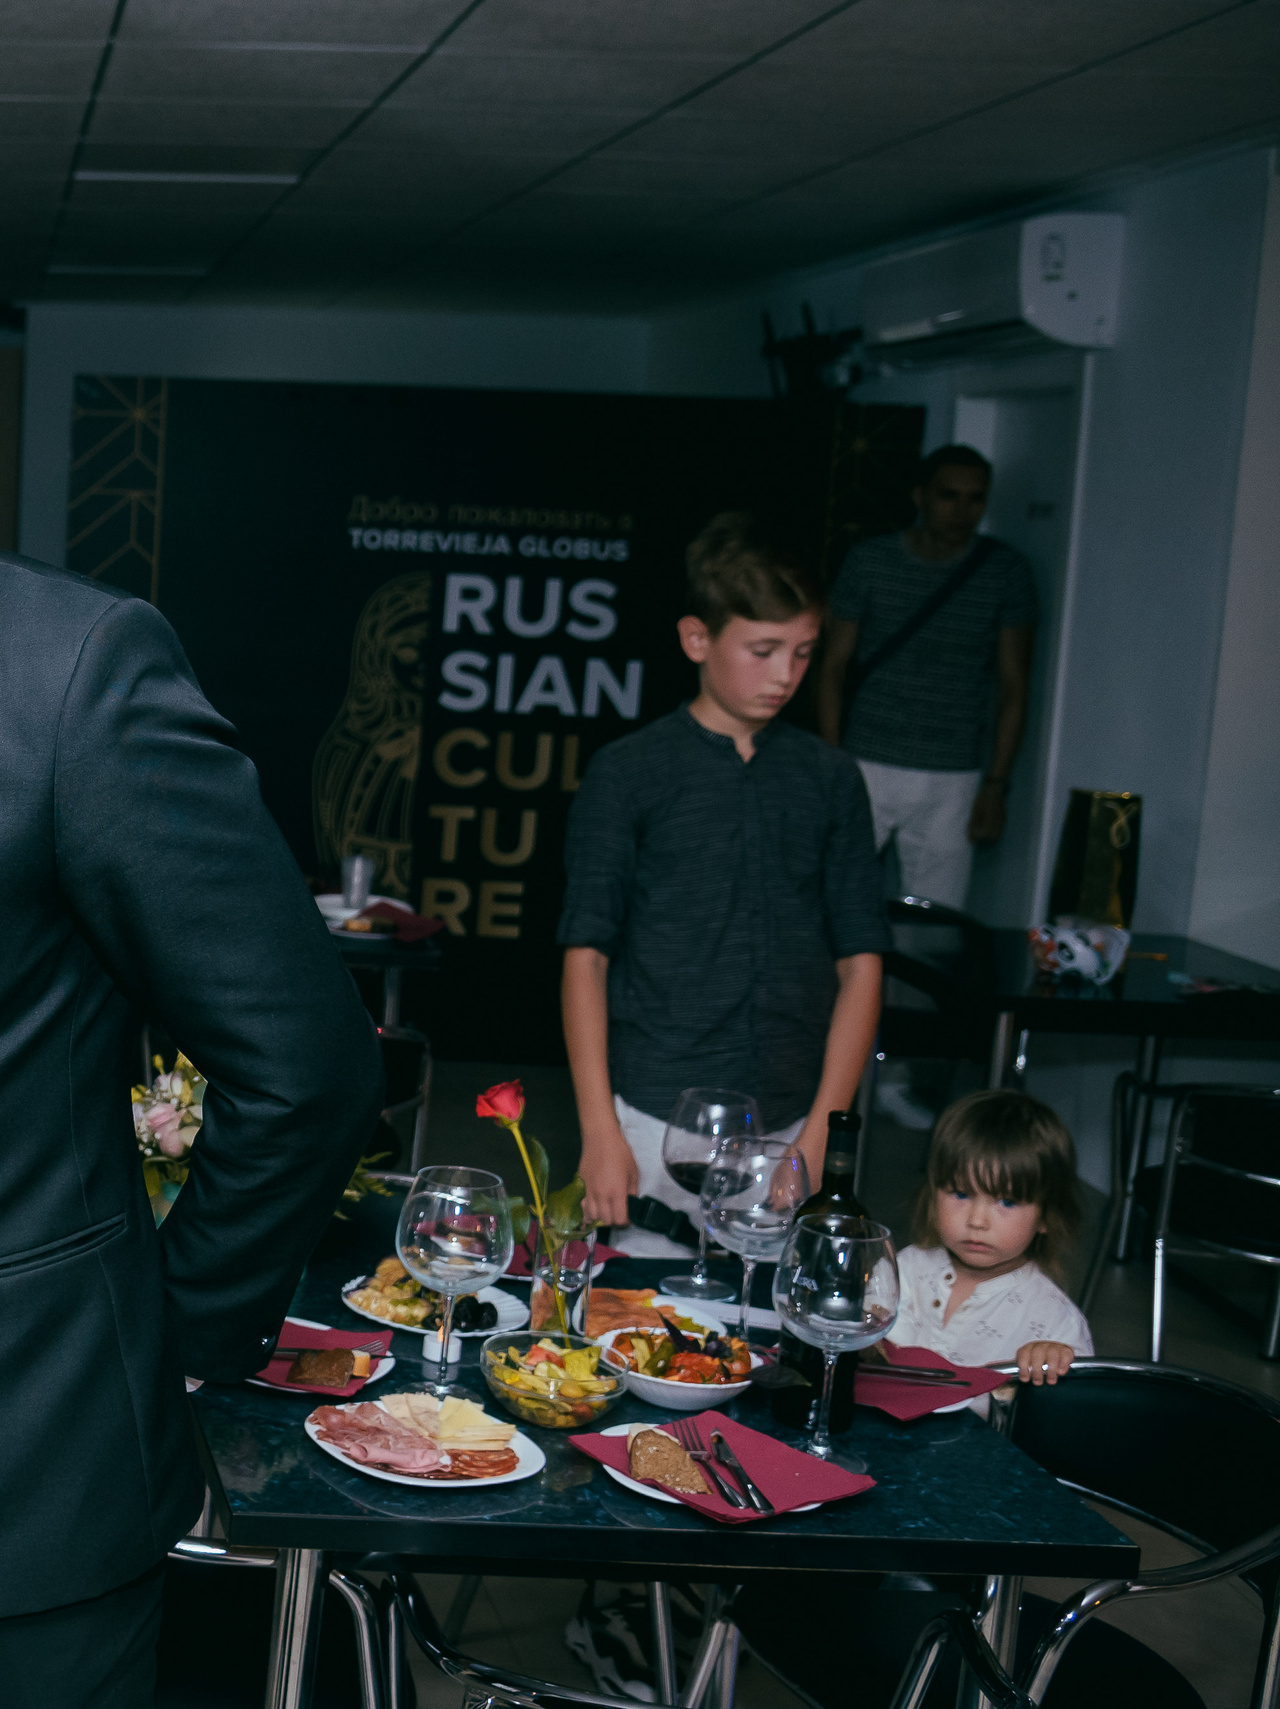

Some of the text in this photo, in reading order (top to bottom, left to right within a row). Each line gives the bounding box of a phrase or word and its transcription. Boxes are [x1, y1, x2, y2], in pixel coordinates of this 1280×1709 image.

[348, 495, 438, 526] Добро
[349, 527, 629, 561] TORREVIEJA GLOBUS
[442, 572, 617, 641] RUS
[439, 650, 643, 719] SIAN
[432, 726, 581, 792] CUL
[428, 803, 538, 867] TU
[421, 877, 525, 939] RE
